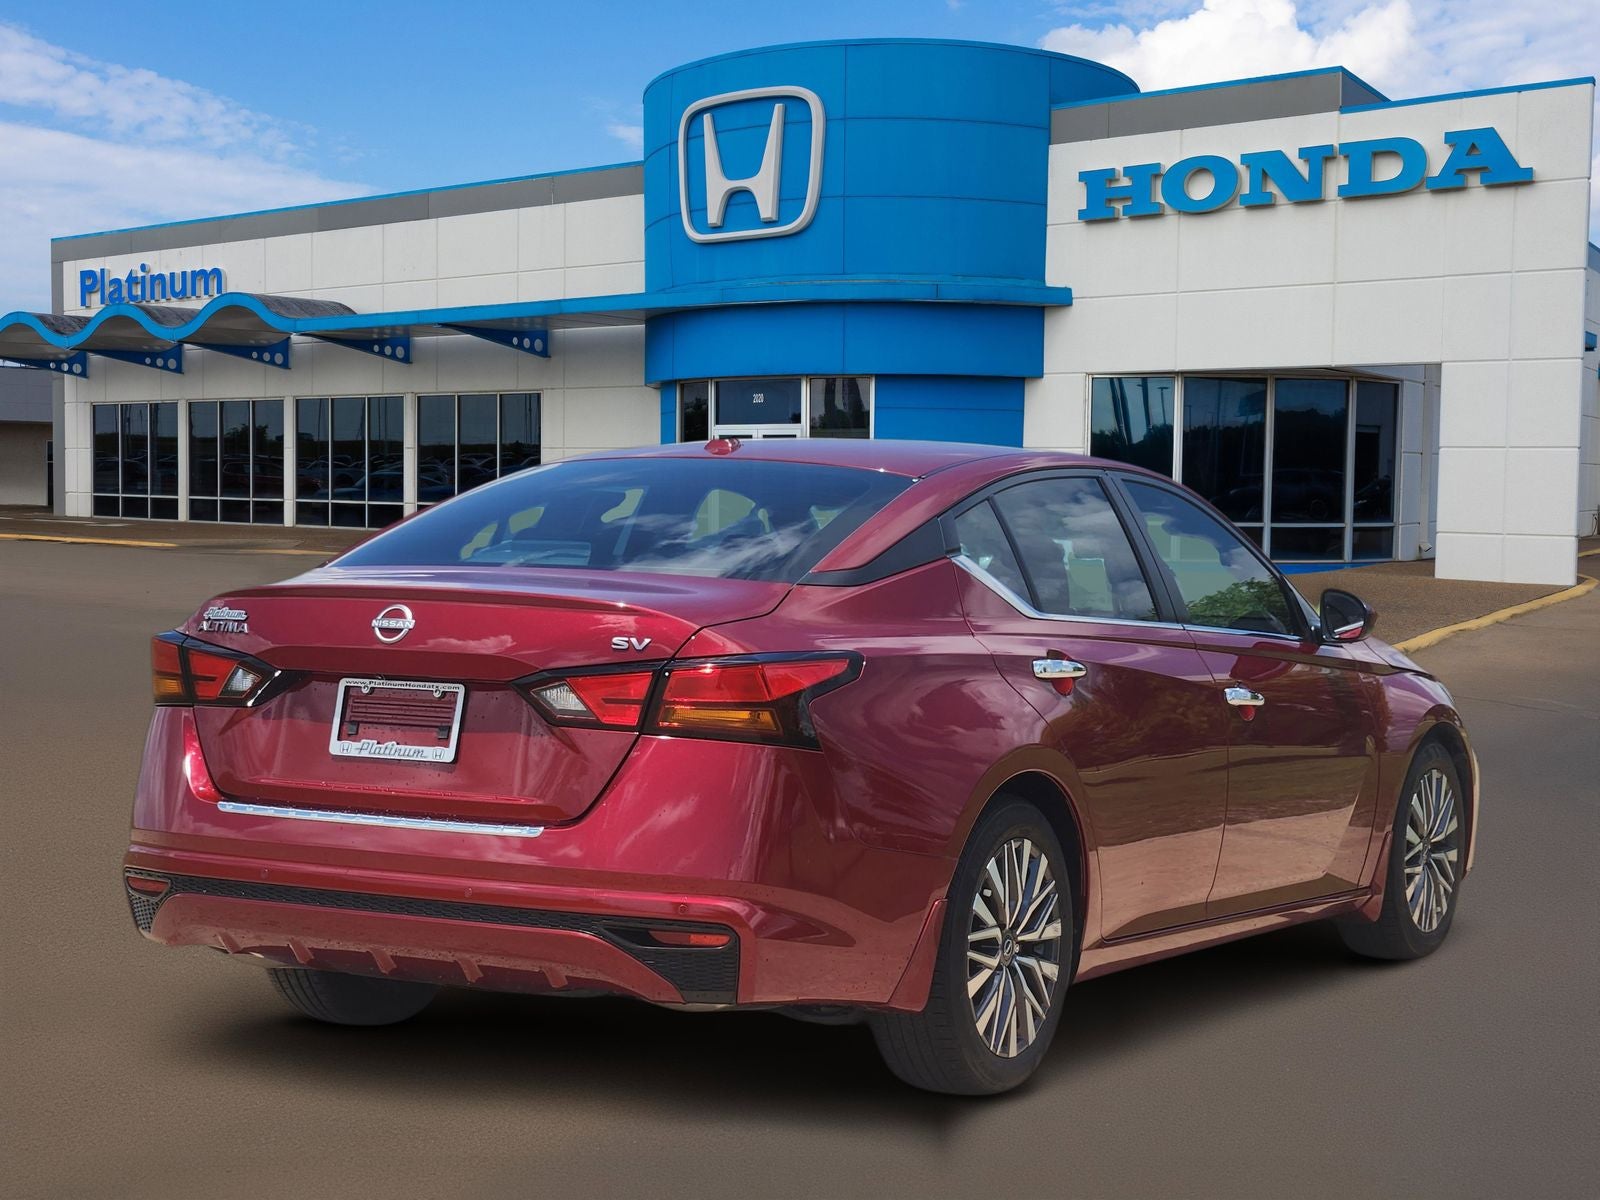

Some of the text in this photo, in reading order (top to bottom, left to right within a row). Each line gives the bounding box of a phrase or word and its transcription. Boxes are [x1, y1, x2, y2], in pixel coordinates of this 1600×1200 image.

[1078, 126, 1534, 221] HONDA
[80, 263, 225, 307] Platinum
[198, 621, 248, 633] ALTIMA
[373, 619, 413, 628] NISSAN
[611, 636, 652, 650] SV
[354, 741, 428, 759] Platinum
